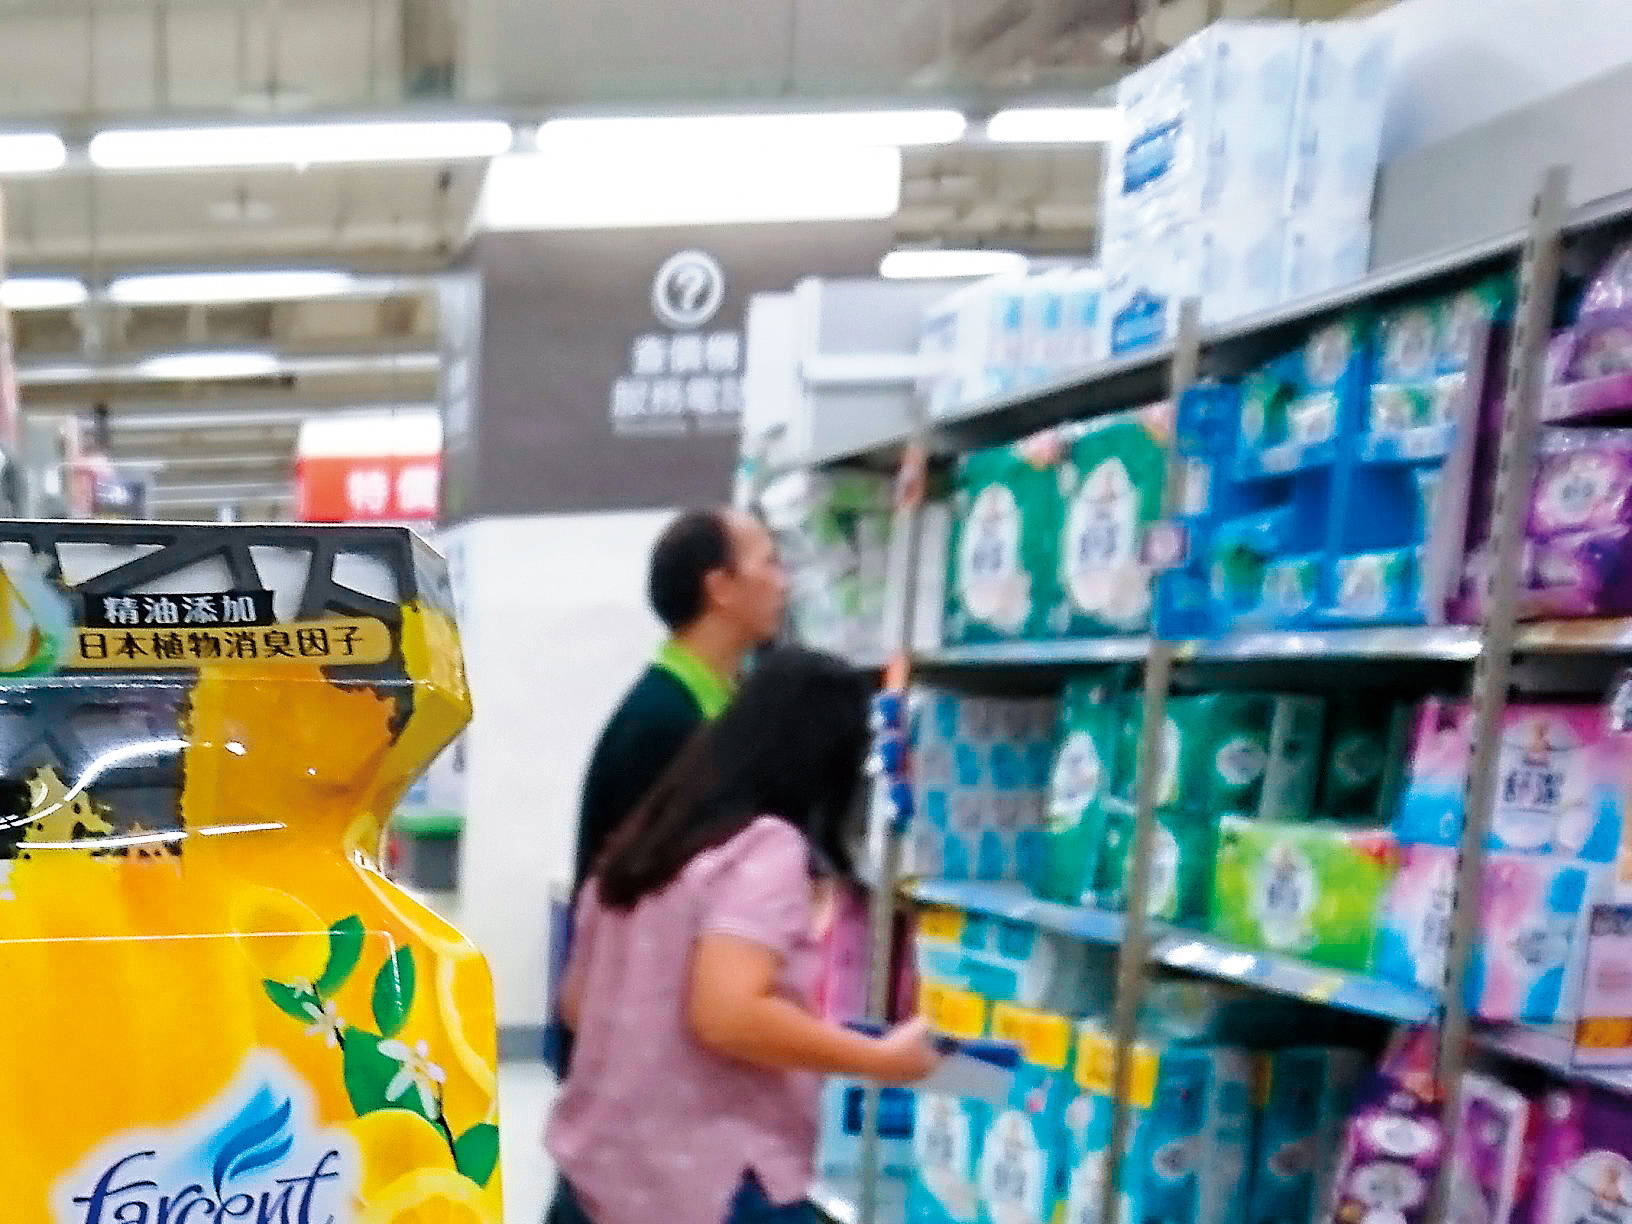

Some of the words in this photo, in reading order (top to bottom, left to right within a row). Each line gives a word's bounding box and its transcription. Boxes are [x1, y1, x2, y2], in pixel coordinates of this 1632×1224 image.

[104, 595, 259, 626] 精油添加
[79, 626, 364, 660] 日本植物消臭因子
